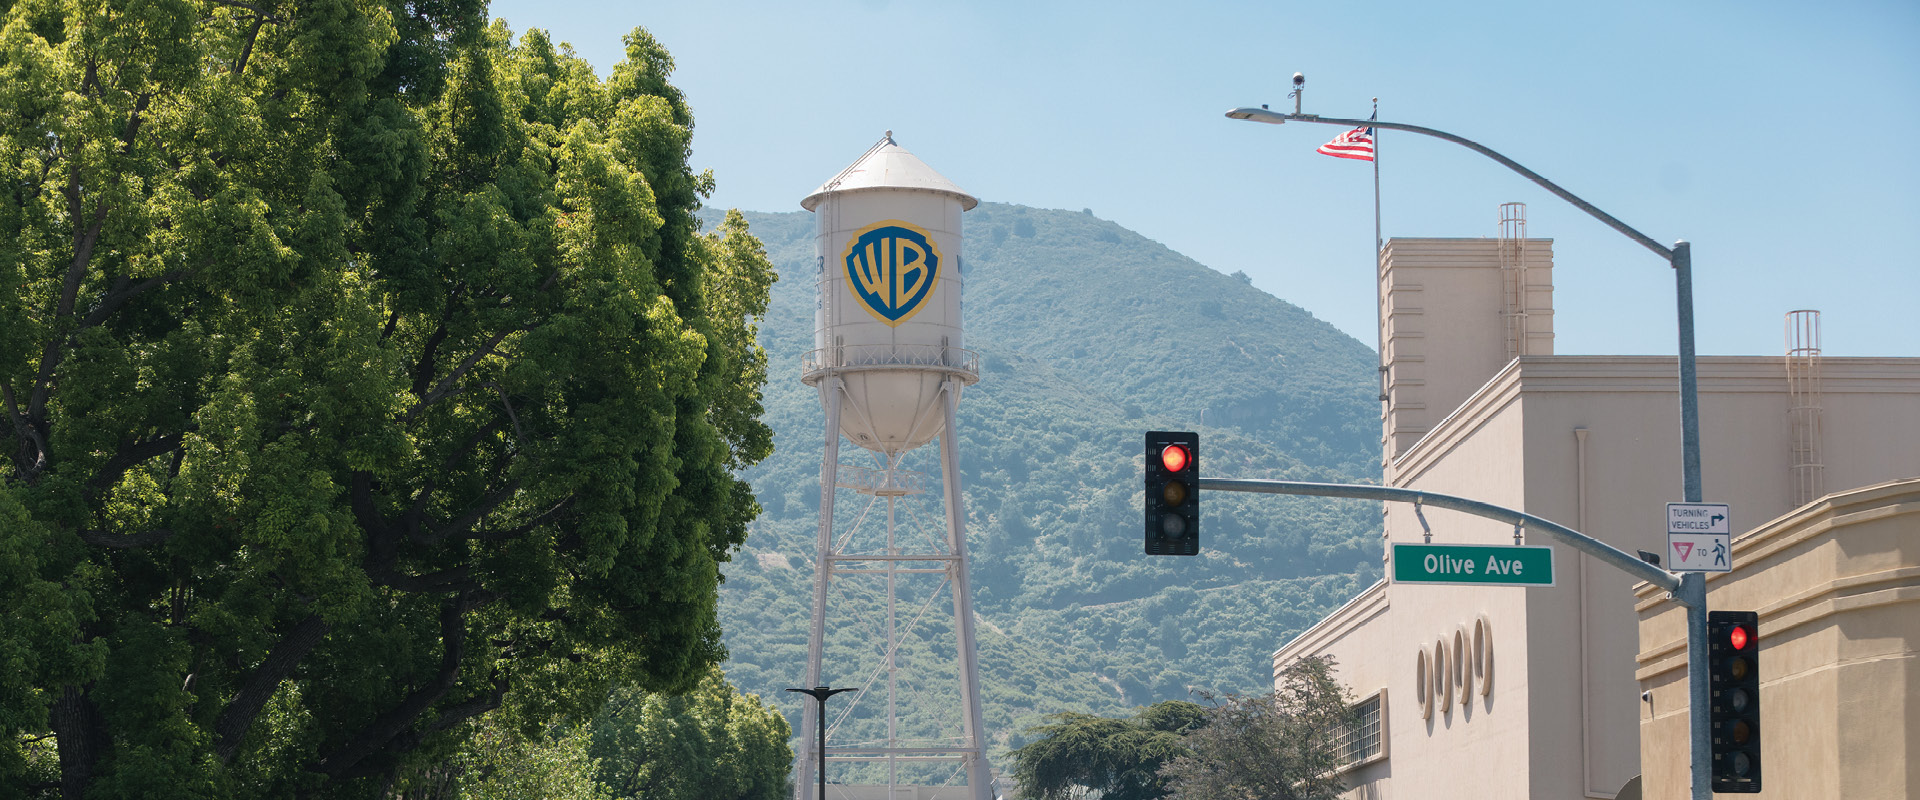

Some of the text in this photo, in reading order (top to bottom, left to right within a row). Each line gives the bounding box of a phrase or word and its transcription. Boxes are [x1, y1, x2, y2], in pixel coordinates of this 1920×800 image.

[853, 237, 929, 310] WB
[1672, 508, 1708, 518] TURNING
[1671, 521, 1710, 530] VEHICLES
[1697, 548, 1708, 557] TO
[1424, 553, 1523, 576] Olive Ave
